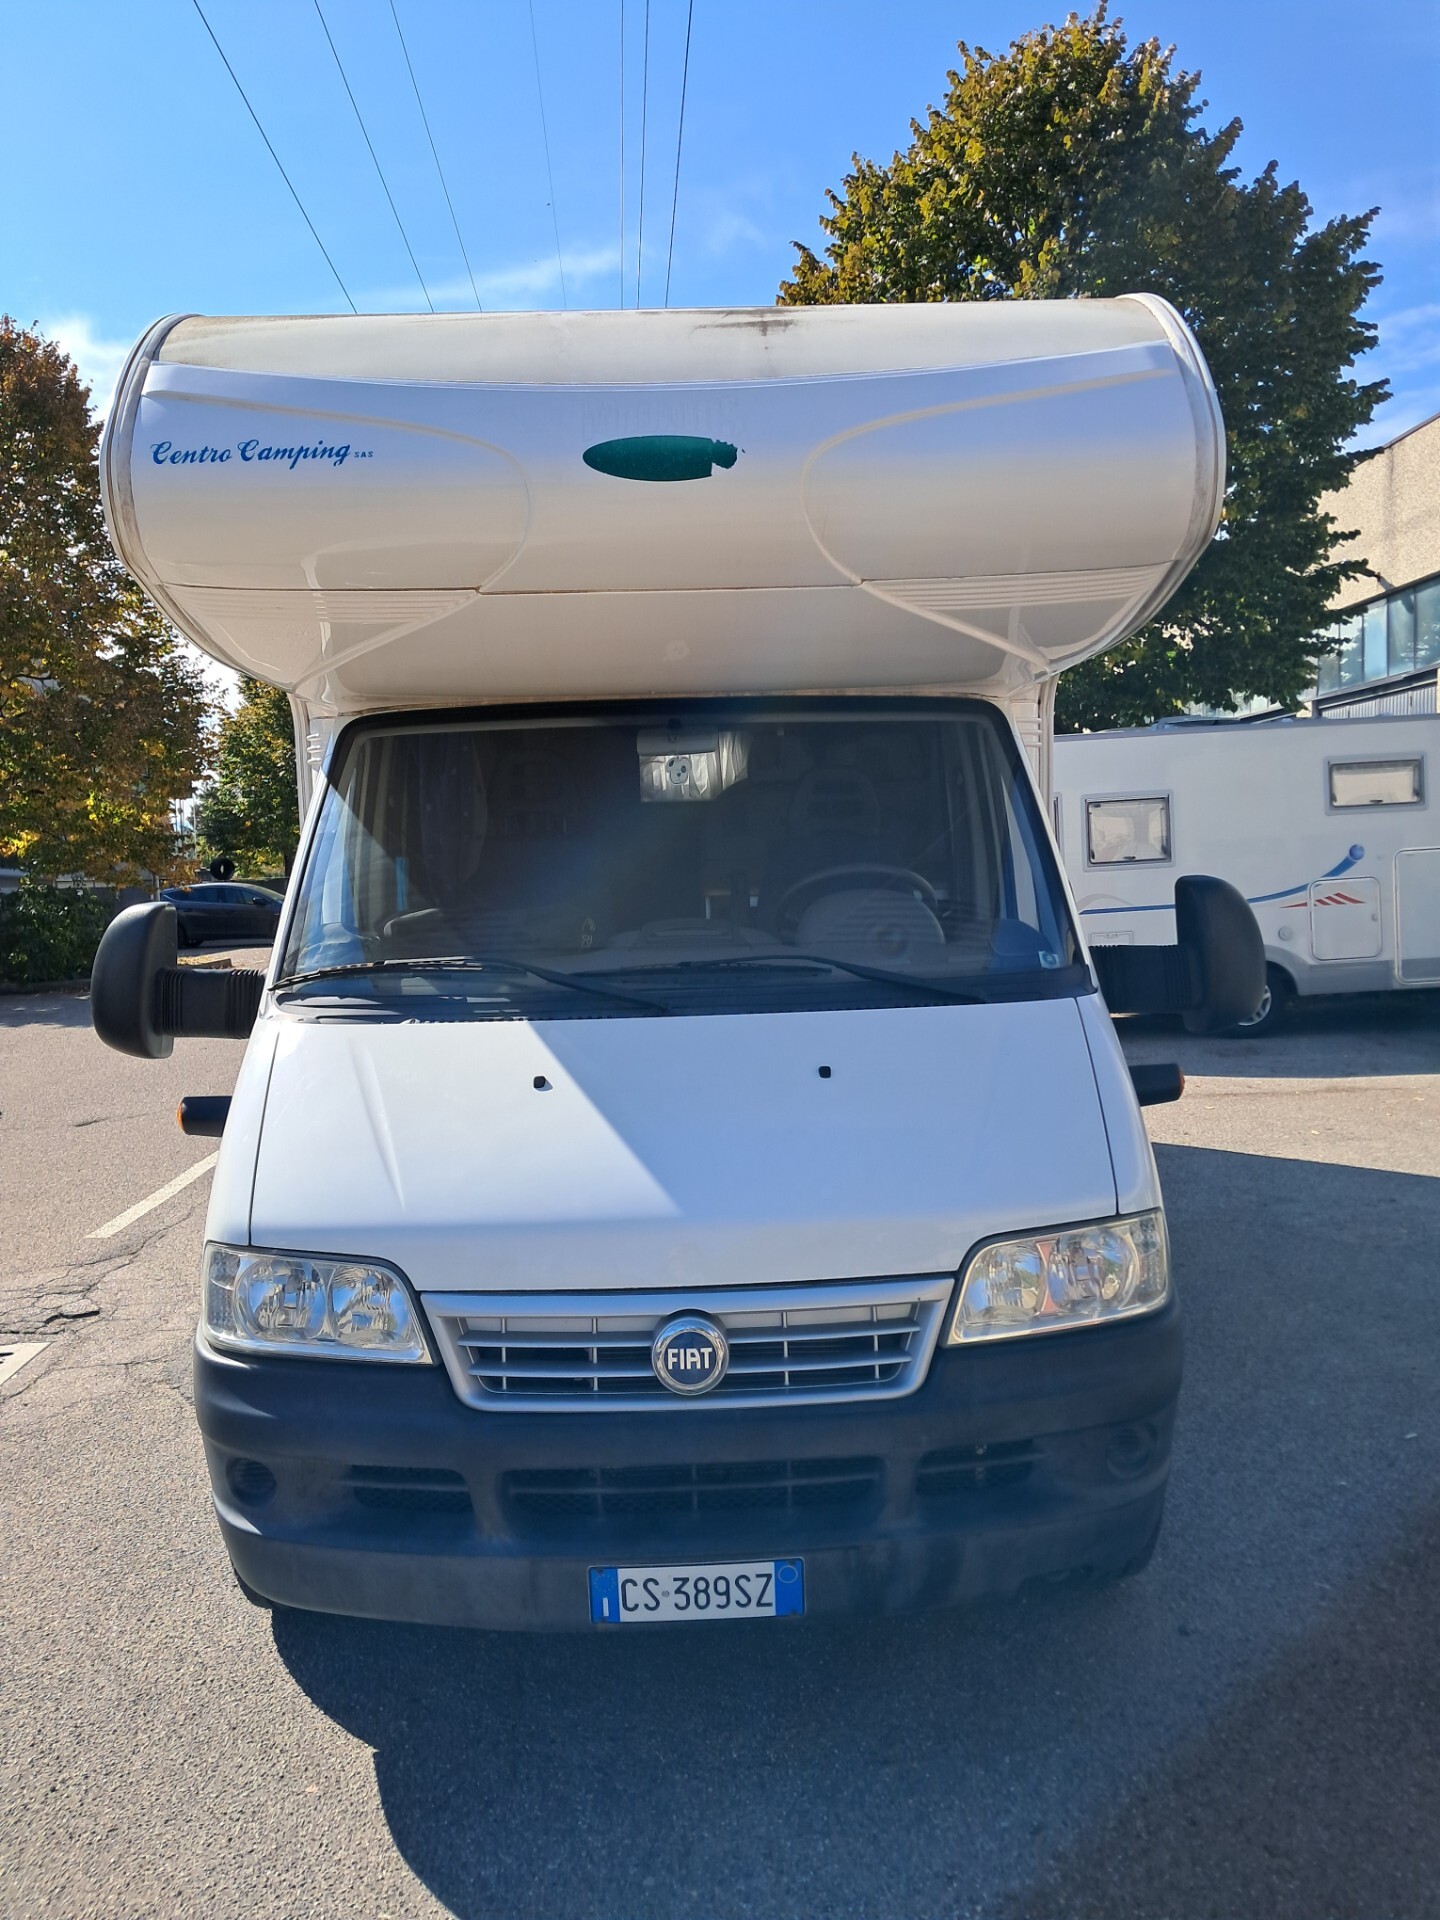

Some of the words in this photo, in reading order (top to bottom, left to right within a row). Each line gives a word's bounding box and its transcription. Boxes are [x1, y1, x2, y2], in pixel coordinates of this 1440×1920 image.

[150, 441, 233, 465] Centro
[237, 439, 351, 470] Camping
[667, 1347, 713, 1370] FIAT
